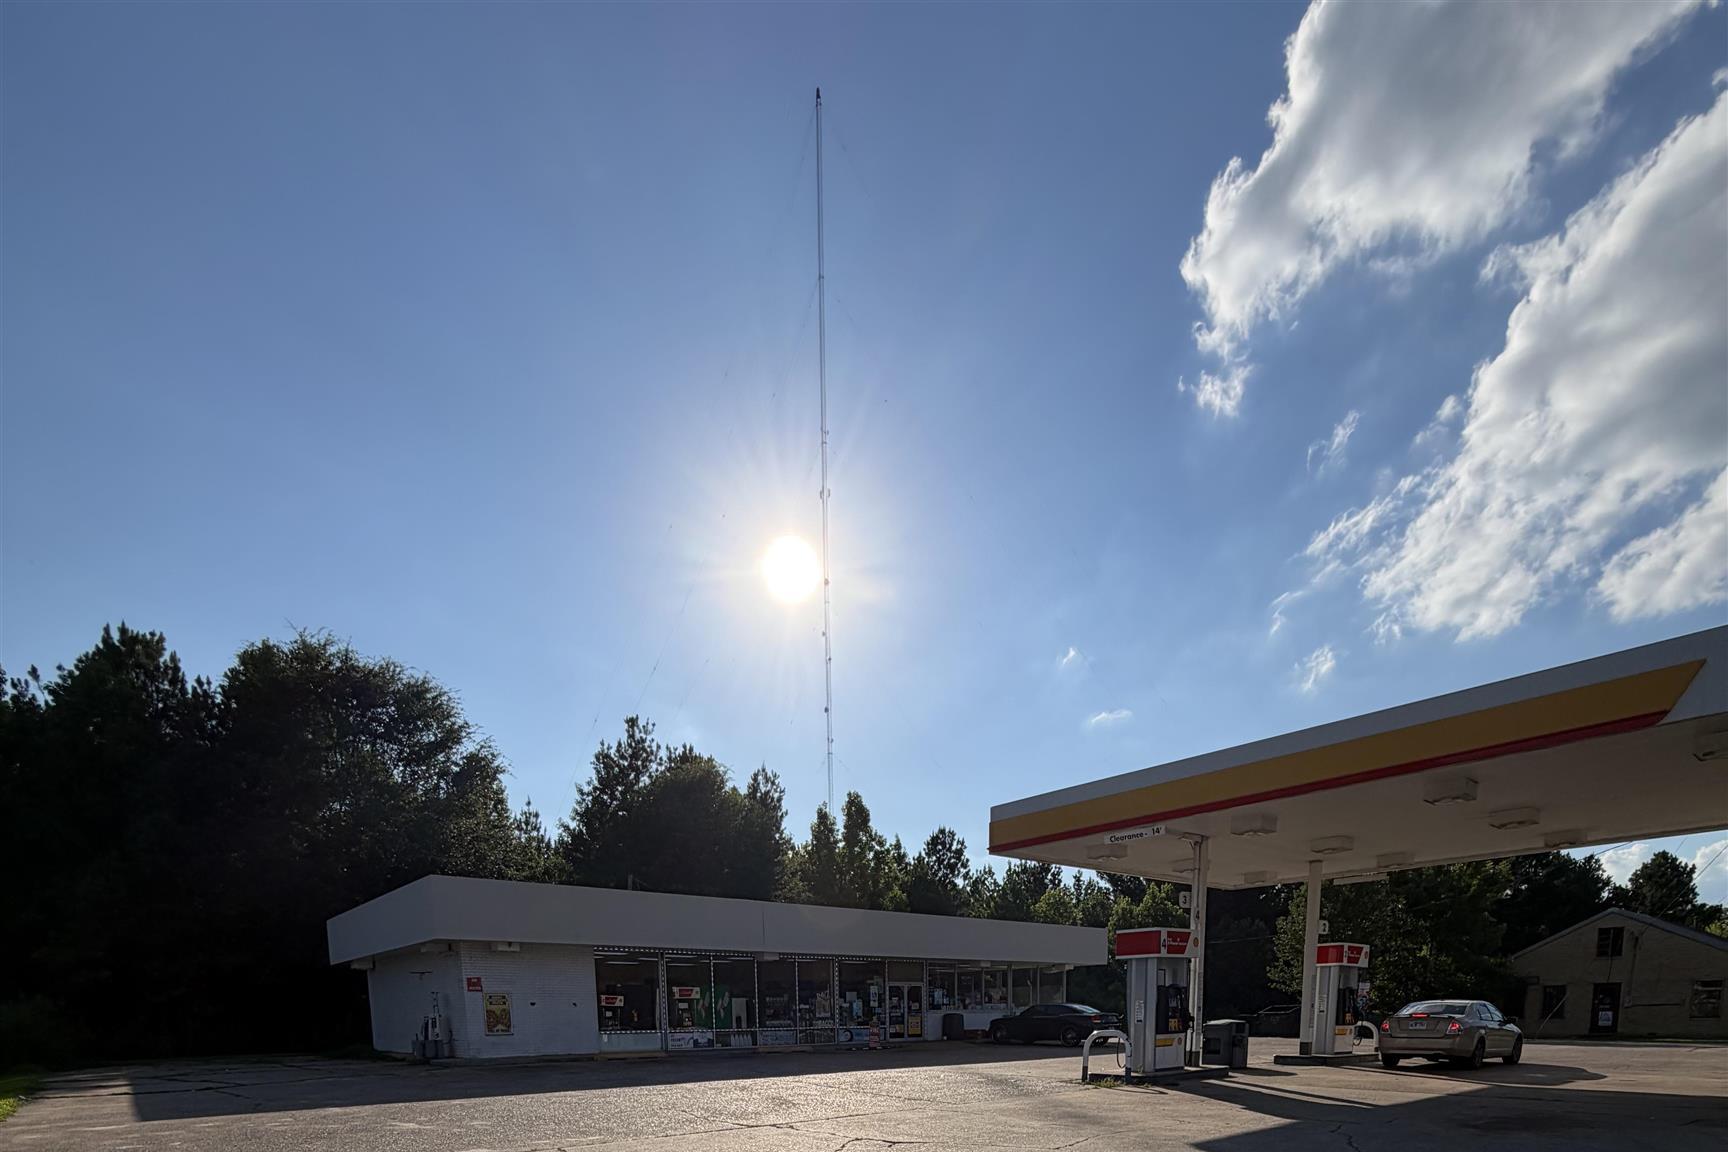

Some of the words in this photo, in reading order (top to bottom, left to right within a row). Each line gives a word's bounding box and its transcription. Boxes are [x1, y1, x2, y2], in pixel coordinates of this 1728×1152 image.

[1109, 831, 1144, 843] Clearance
[1182, 895, 1187, 904] 3
[1161, 938, 1167, 949] 4
